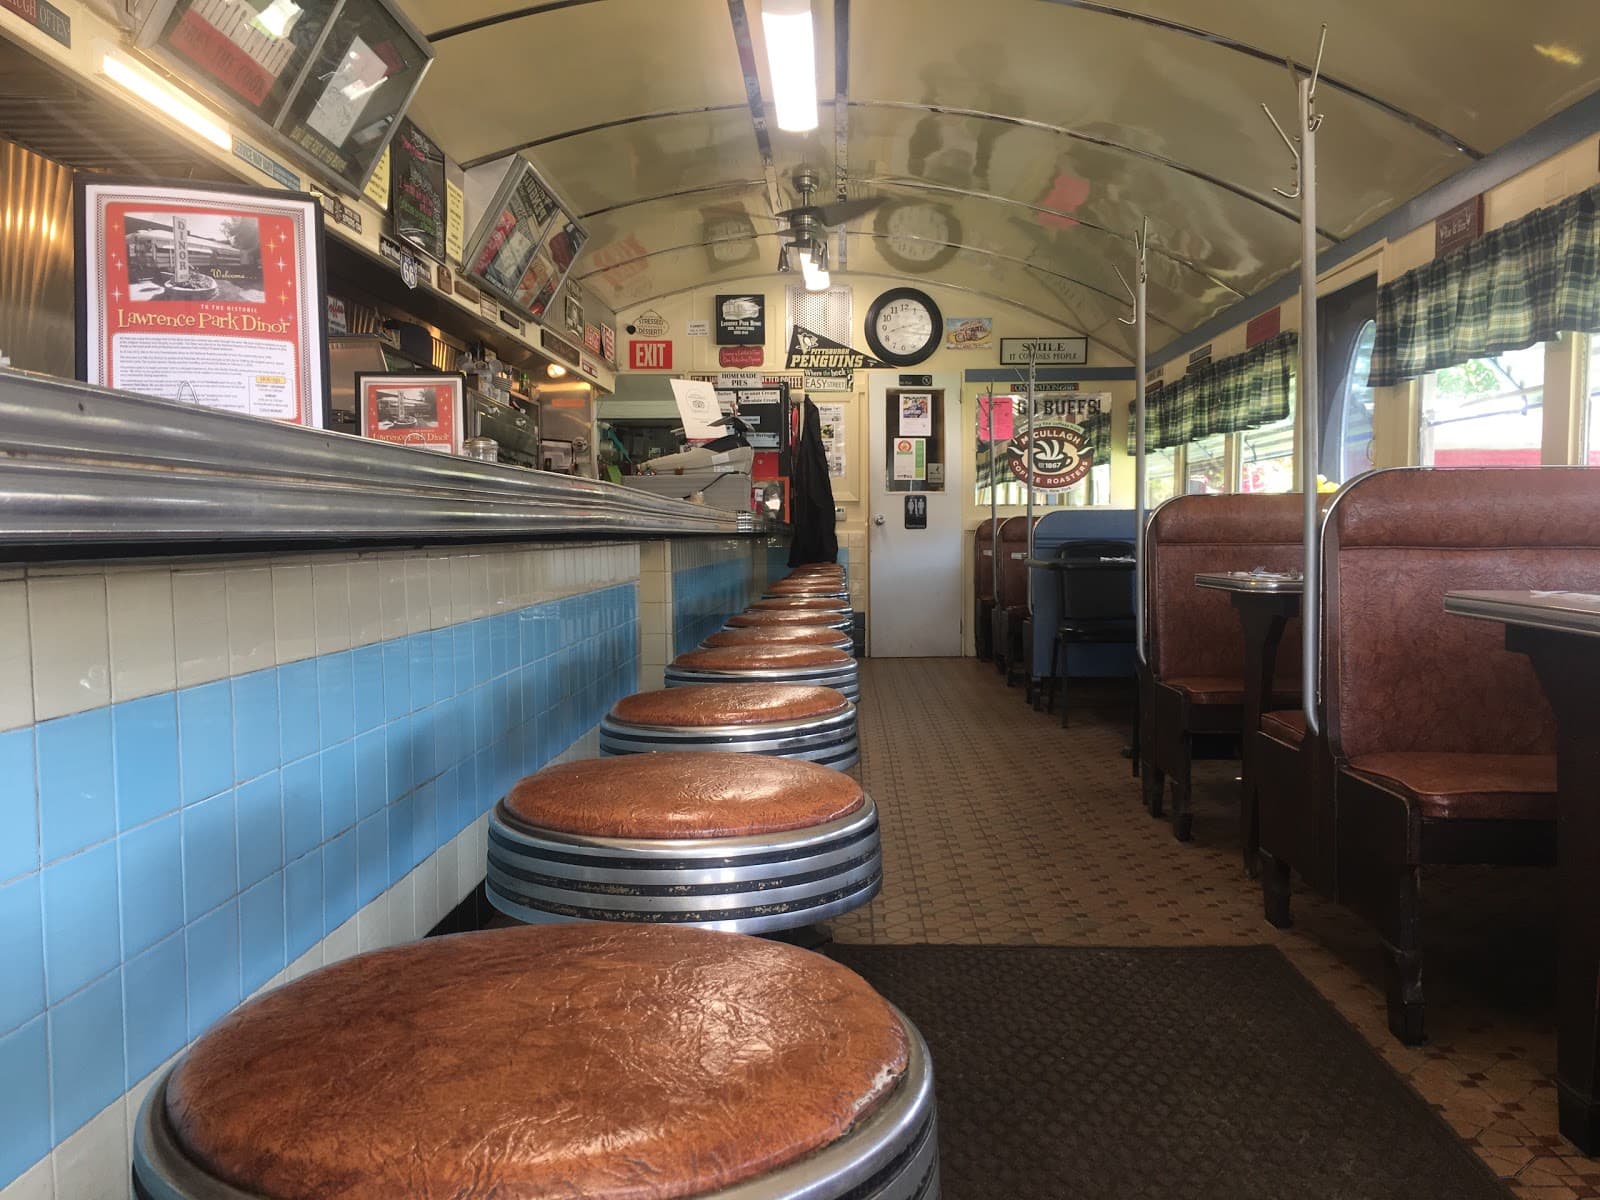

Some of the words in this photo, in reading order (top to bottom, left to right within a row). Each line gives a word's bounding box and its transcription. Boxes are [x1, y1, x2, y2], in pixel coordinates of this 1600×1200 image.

[177, 221, 187, 271] DINOR
[403, 262, 415, 284] 66
[890, 306, 898, 314] 11
[118, 309, 196, 328] Lawrence
[198, 312, 240, 330] Park
[241, 315, 291, 334] Dinor
[883, 314, 892, 322] 10
[1022, 342, 1066, 352] SMILE
[635, 343, 666, 367] EXIT
[790, 355, 864, 368] PENGUINS
[1053, 352, 1077, 360] PEOPLE
[805, 369, 822, 377] Where
[805, 377, 827, 389] EASY
[1044, 399, 1101, 416] BUFFS!
[373, 433, 406, 441] Lawrence
[428, 432, 449, 441] Dinor
[1020, 429, 1082, 446] MCULLAGH
[1012, 459, 1041, 484] COFE
[1046, 460, 1090, 486] ROASTERS
